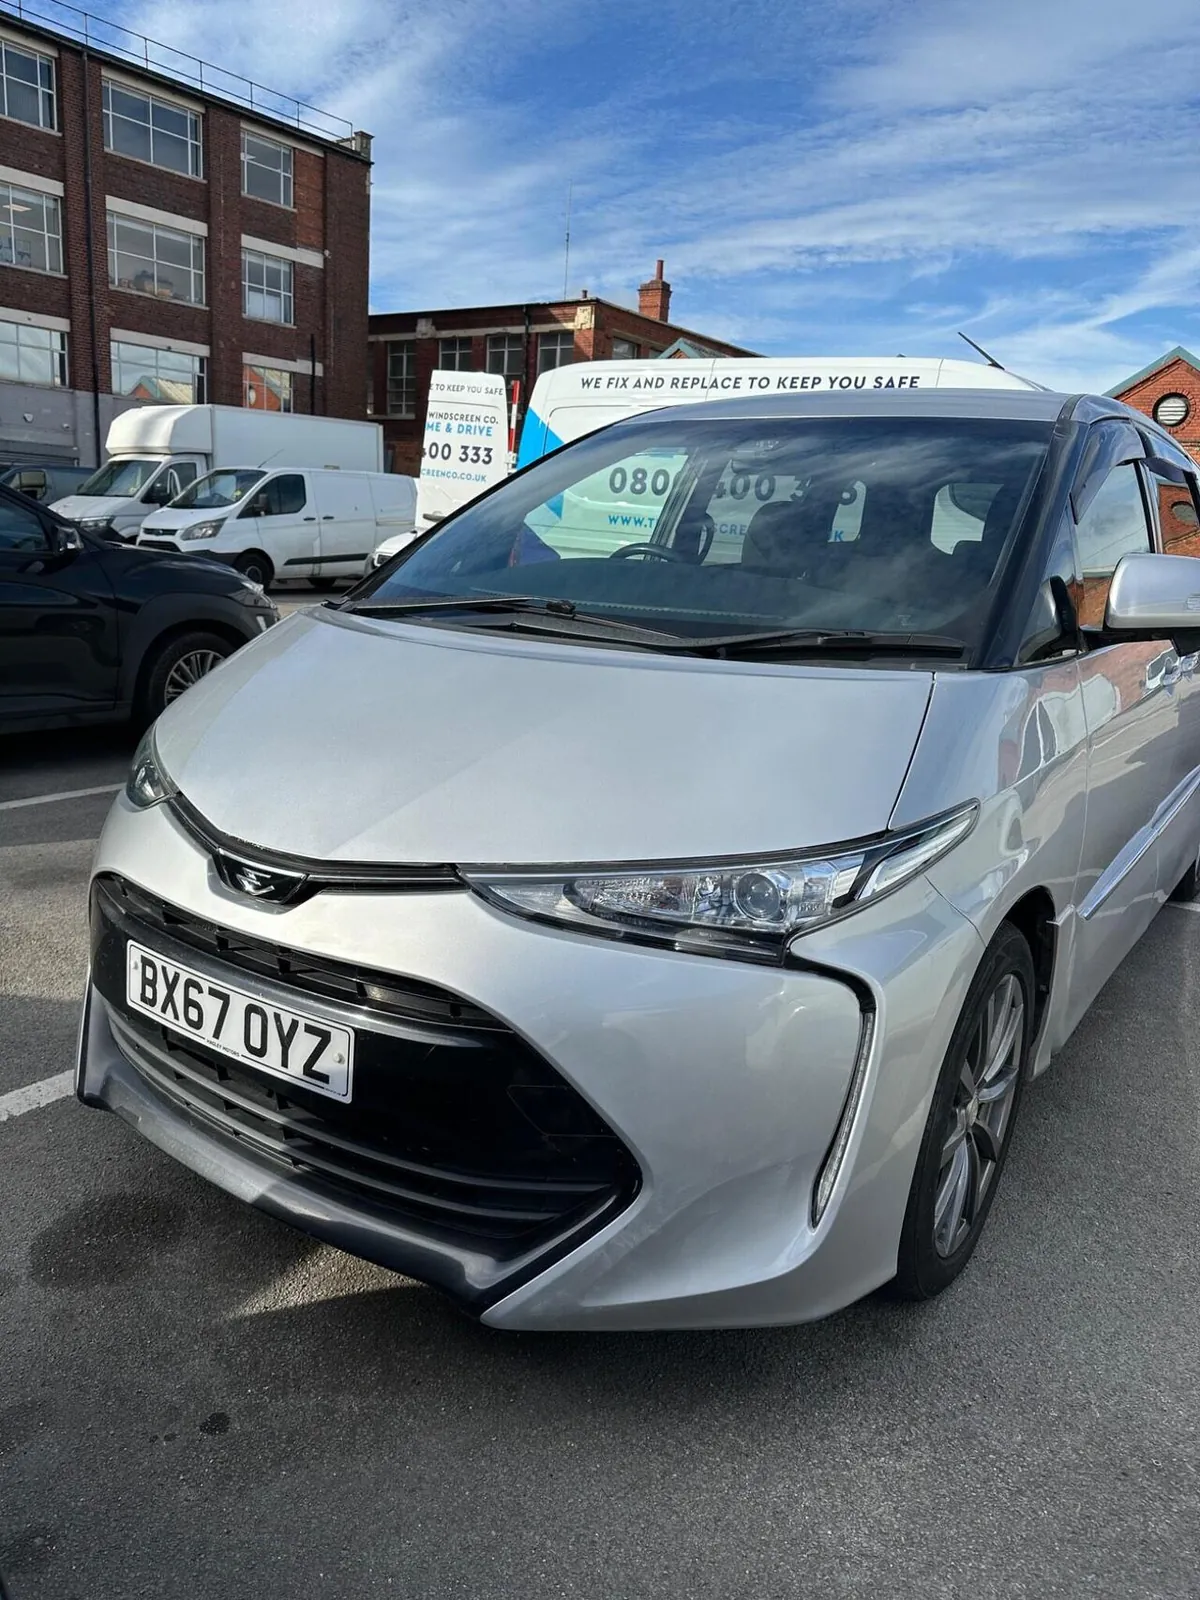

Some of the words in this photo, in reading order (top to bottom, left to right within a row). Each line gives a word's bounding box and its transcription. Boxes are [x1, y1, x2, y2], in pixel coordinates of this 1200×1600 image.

[435, 383, 446, 391] TO
[446, 384, 466, 393] KEEP
[467, 385, 482, 394] YOU
[484, 386, 504, 396] SAFE
[581, 377, 602, 389] WE
[607, 377, 629, 389] FIX
[633, 377, 665, 389] AND
[670, 377, 742, 389] REPLACE
[748, 377, 770, 389] TO
[777, 376, 822, 389] KEEP
[829, 376, 867, 389] YOU
[873, 376, 920, 389] SAFE
[428, 411, 481, 423] WINDSCREEN
[483, 415, 499, 425] CO.
[445, 422, 452, 433] &
[457, 423, 493, 437] DRIVE
[458, 445, 493, 465] 333
[140, 954, 231, 1041] BX67
[244, 1003, 332, 1085] OYZ
